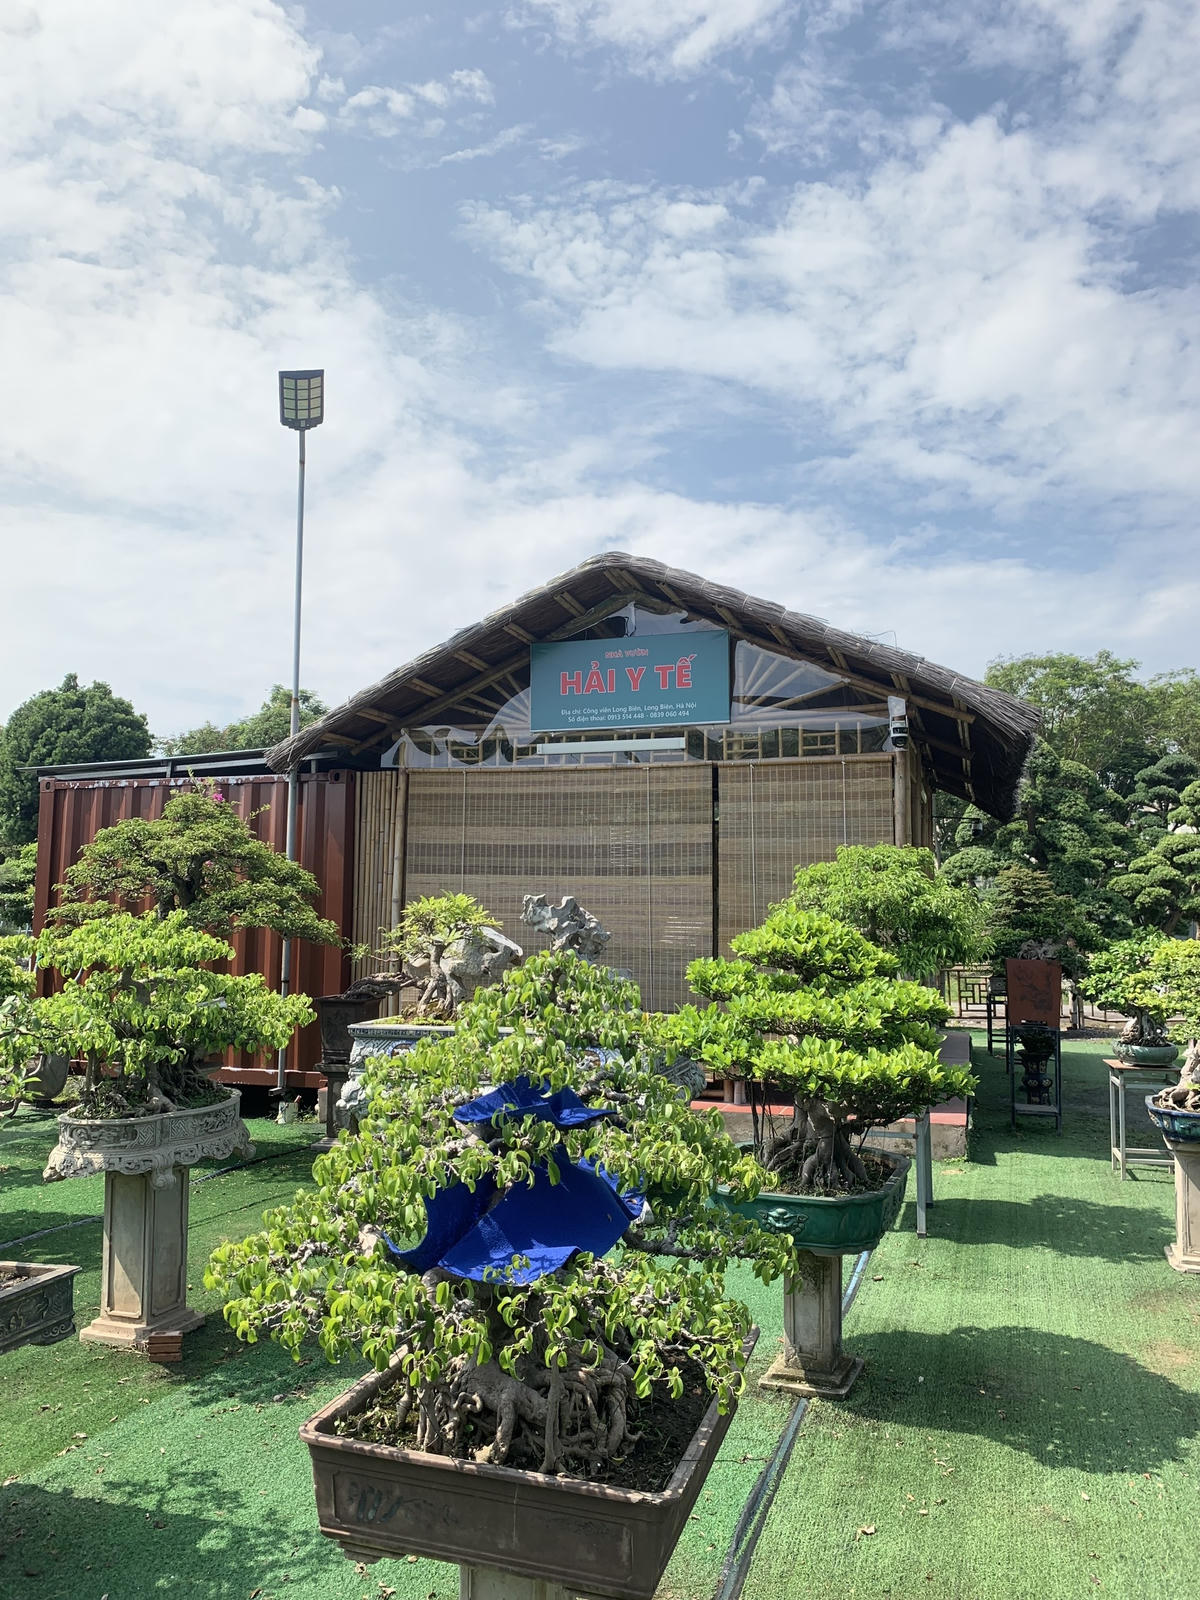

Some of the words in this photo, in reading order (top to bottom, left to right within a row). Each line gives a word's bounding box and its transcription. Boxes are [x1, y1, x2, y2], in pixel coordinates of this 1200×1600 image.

[560, 660, 616, 695] HẢI
[625, 666, 646, 691] Y
[654, 653, 697, 690] TẾ
[561, 708, 571, 716] Địa
[583, 706, 598, 715] Công
[600, 705, 611, 713] viên
[612, 705, 628, 714] Long
[685, 701, 697, 709] Nội
[568, 714, 576, 723] Số
[576, 714, 589, 723] điện
[607, 713, 621, 721] 0913
